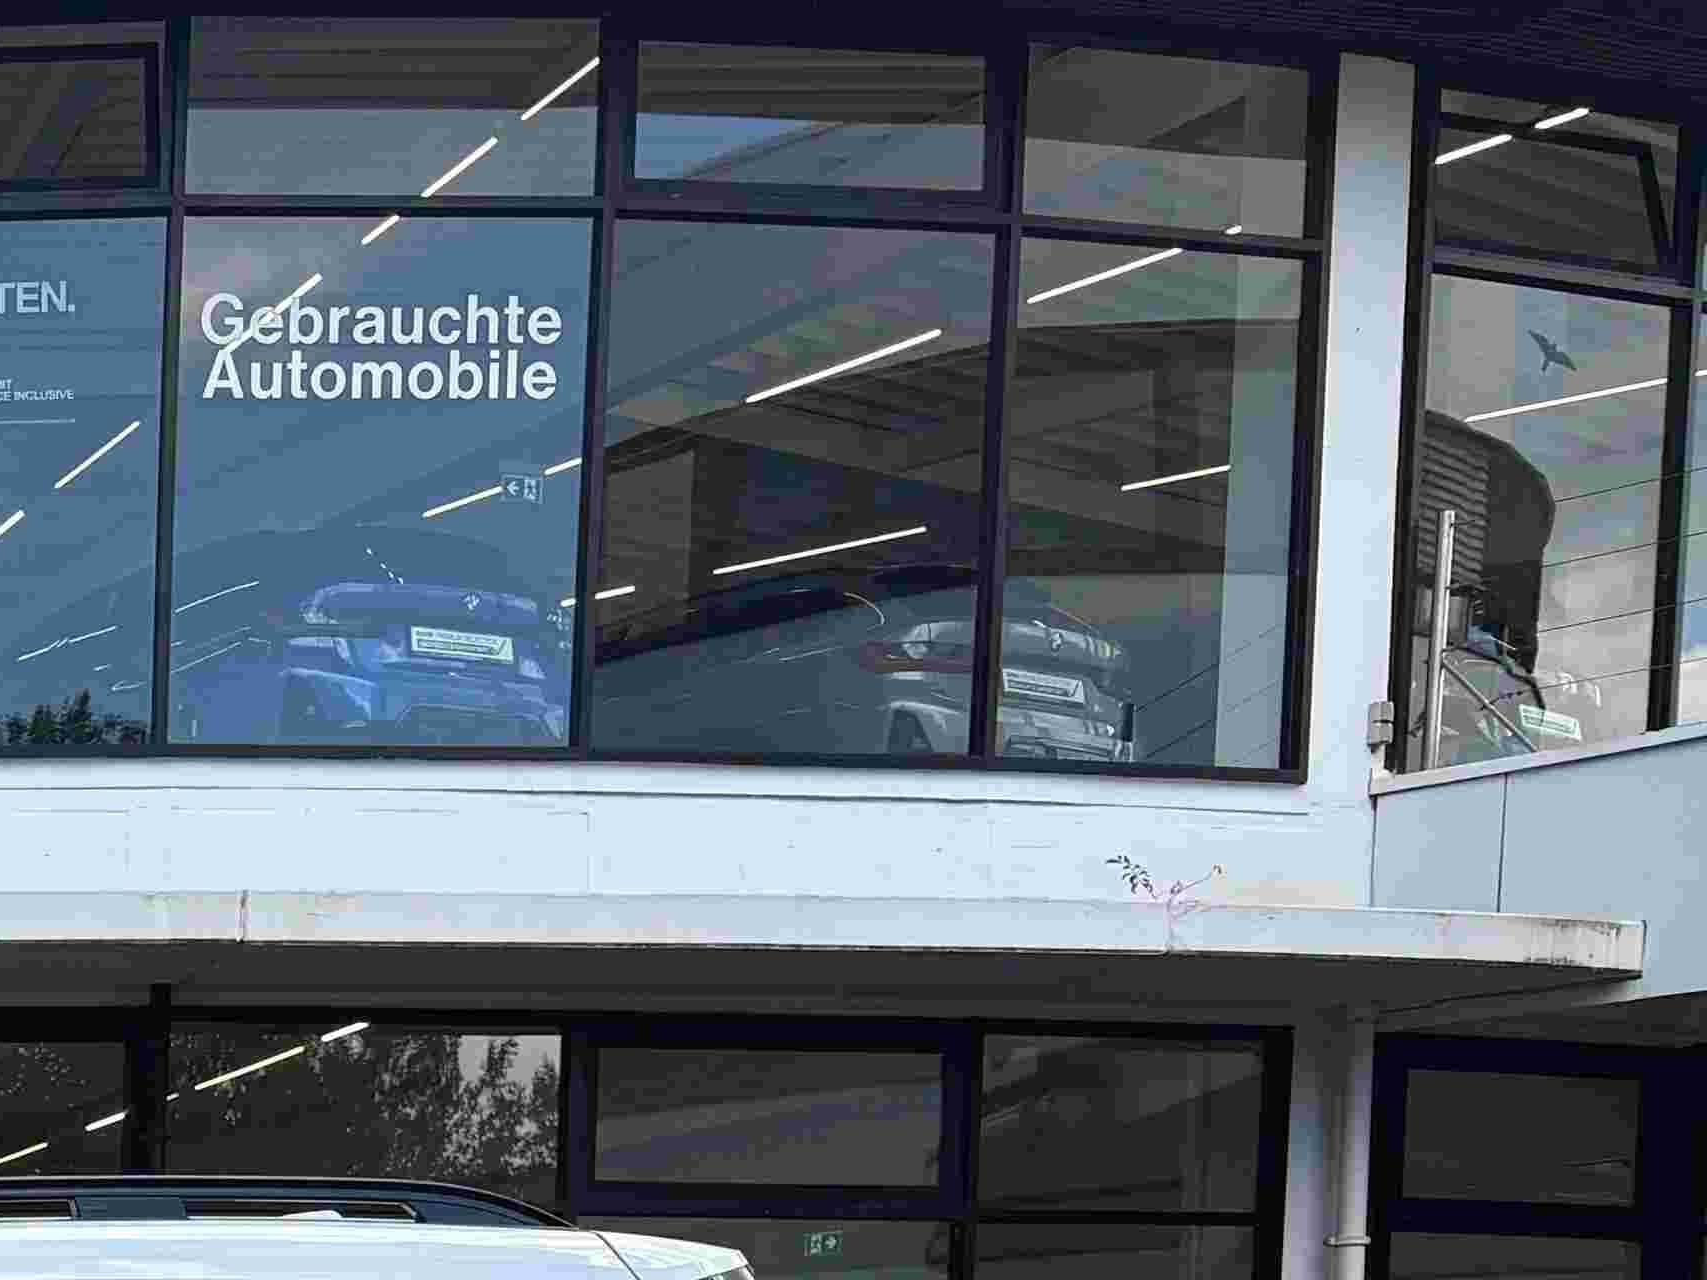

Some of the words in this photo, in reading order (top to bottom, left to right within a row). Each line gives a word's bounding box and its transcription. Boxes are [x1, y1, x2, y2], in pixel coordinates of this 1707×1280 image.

[200, 292, 563, 346] Gebrauchte
[14, 389, 75, 401] INCLUSIVE
[202, 349, 558, 400] Automobile
